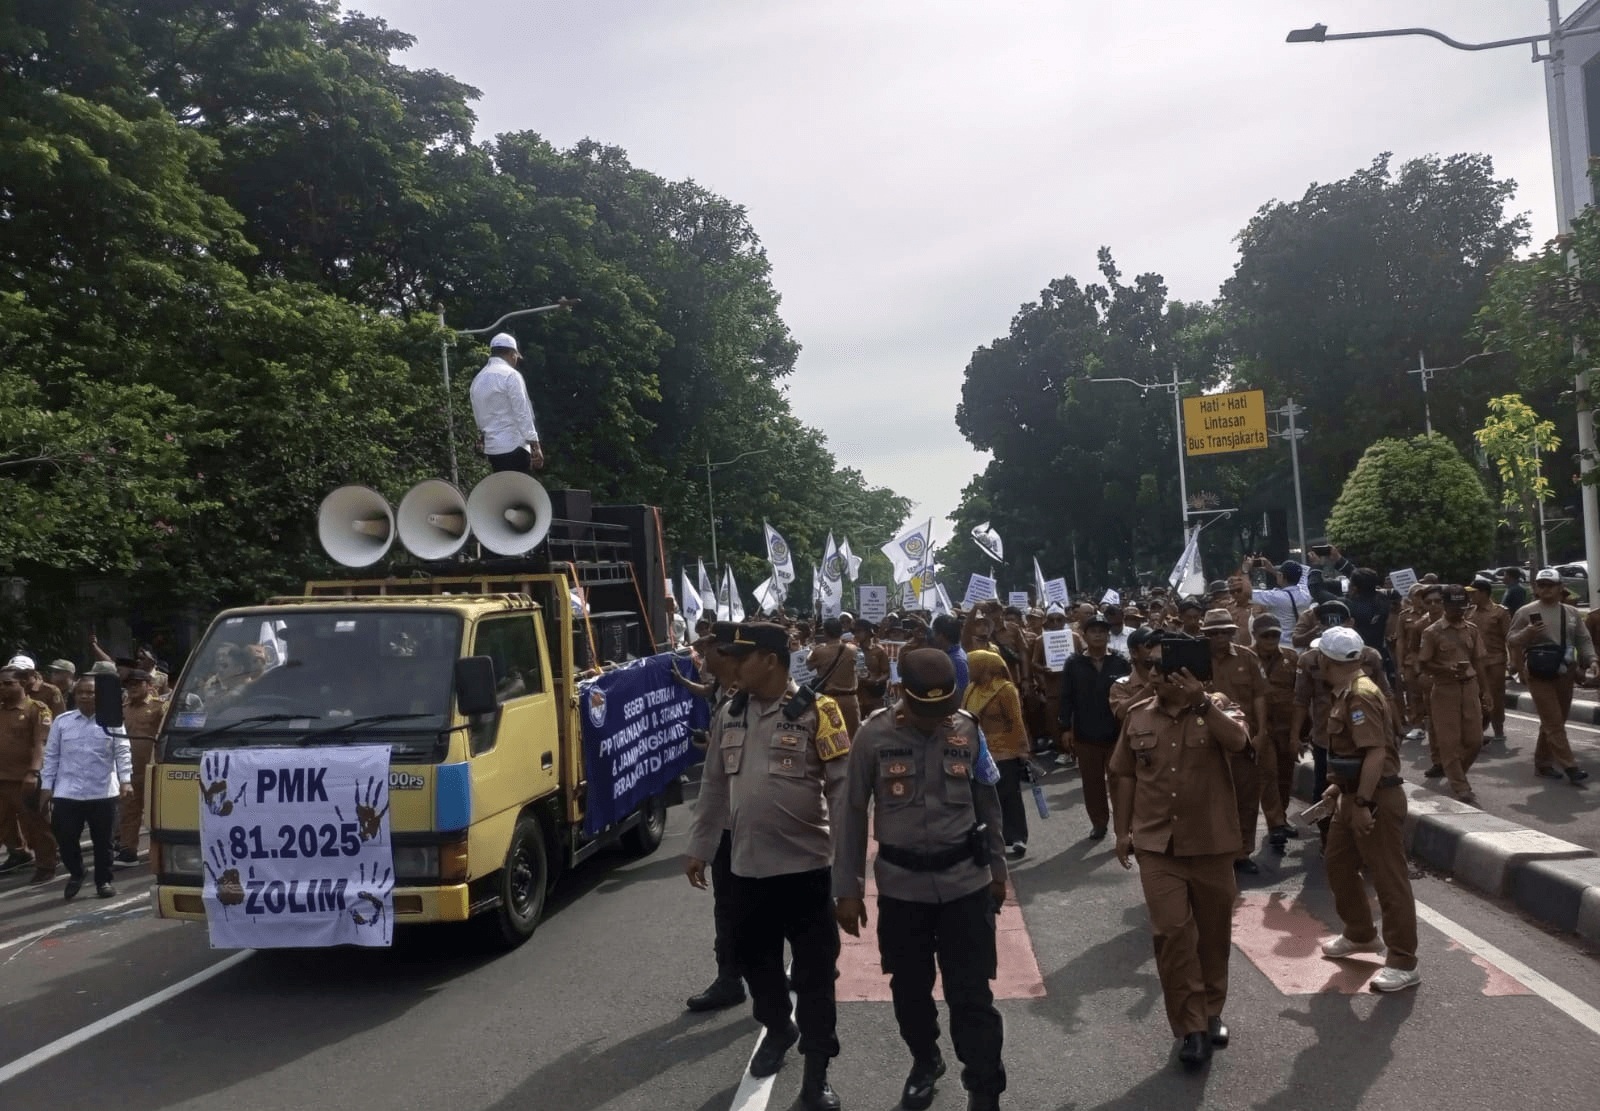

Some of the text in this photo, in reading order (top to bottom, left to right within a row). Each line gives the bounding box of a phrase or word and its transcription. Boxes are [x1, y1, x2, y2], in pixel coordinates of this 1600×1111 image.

[1200, 398, 1219, 414] Hati
[1227, 395, 1247, 410] Hati
[1204, 415, 1246, 430] Lintasan
[1188, 430, 1265, 450] Bus Transjakarta
[256, 766, 329, 803] PMK
[388, 771, 425, 786] 00PS
[229, 823, 361, 859] 81.2025
[245, 878, 348, 915] ZOLIM
